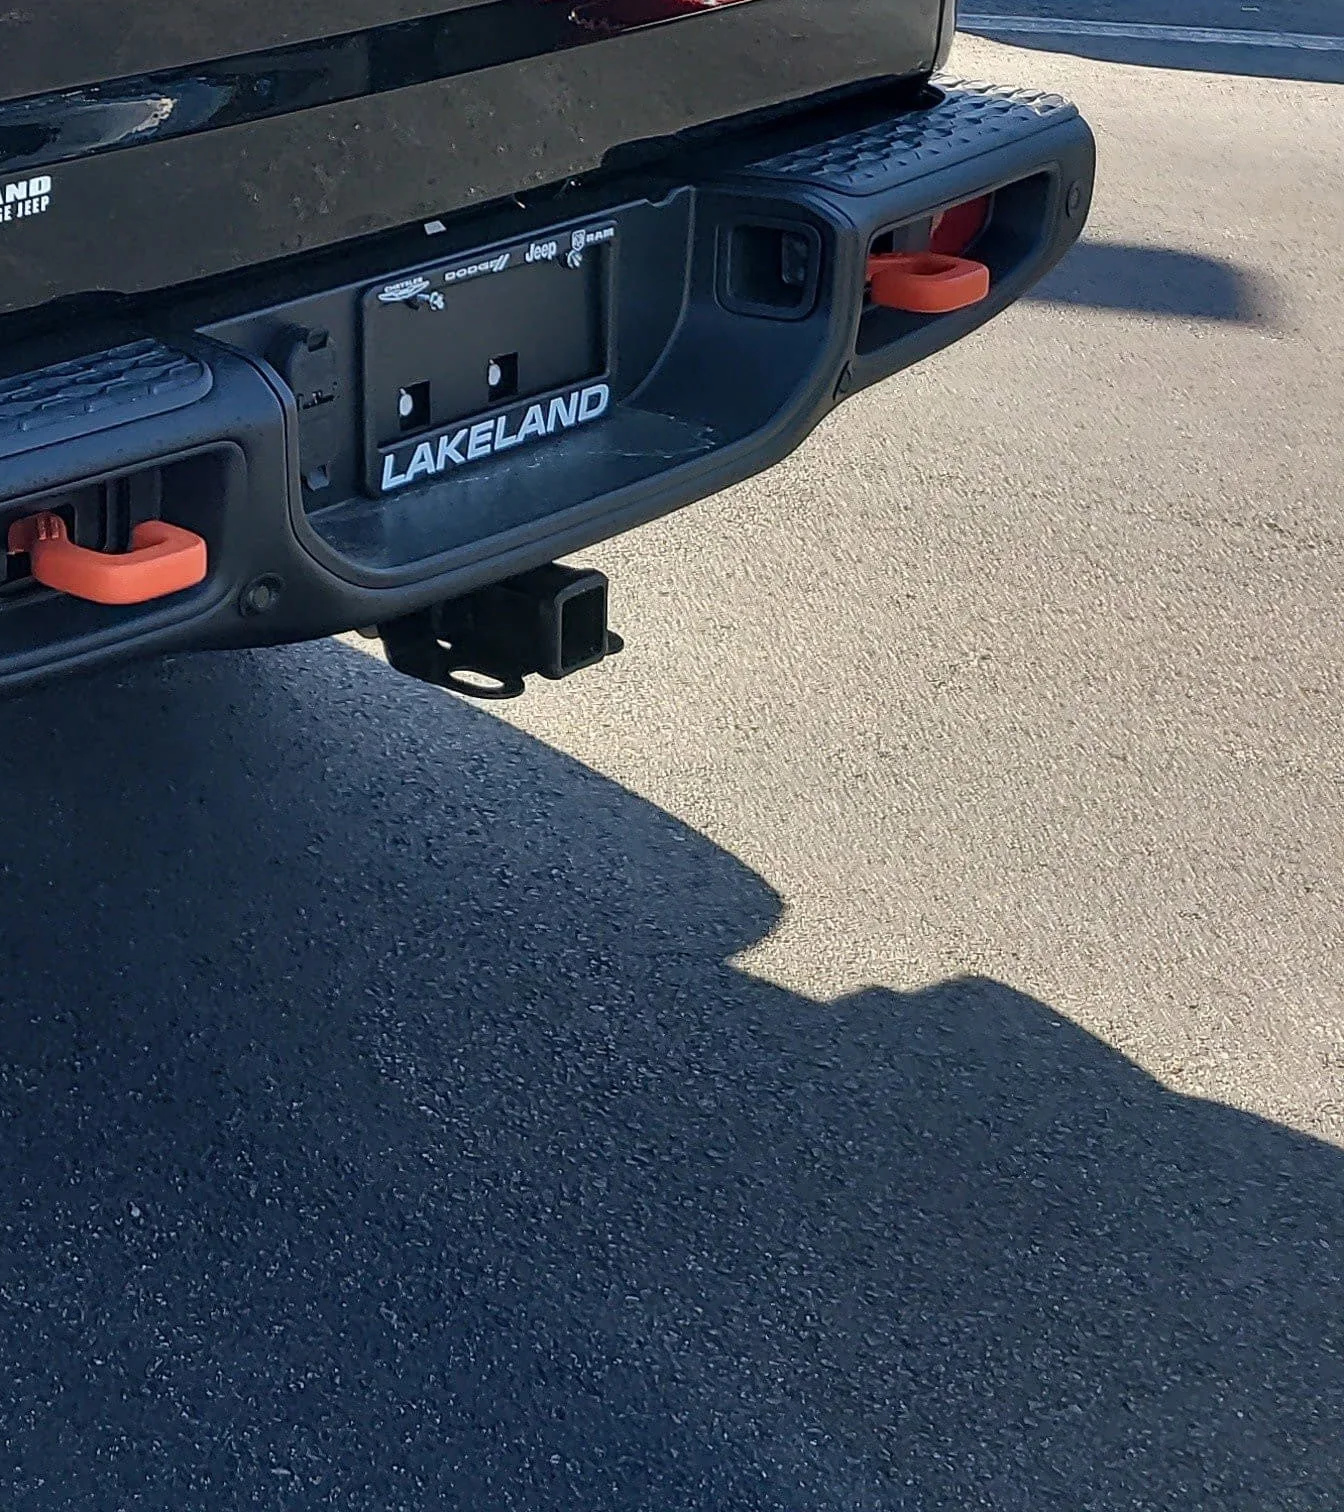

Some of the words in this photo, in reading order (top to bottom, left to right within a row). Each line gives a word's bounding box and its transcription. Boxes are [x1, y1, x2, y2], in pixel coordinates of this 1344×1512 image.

[17, 195, 50, 219] JEEP
[525, 240, 557, 264] Jeep
[586, 227, 615, 244] RAM
[381, 383, 610, 491] LAKELAND
